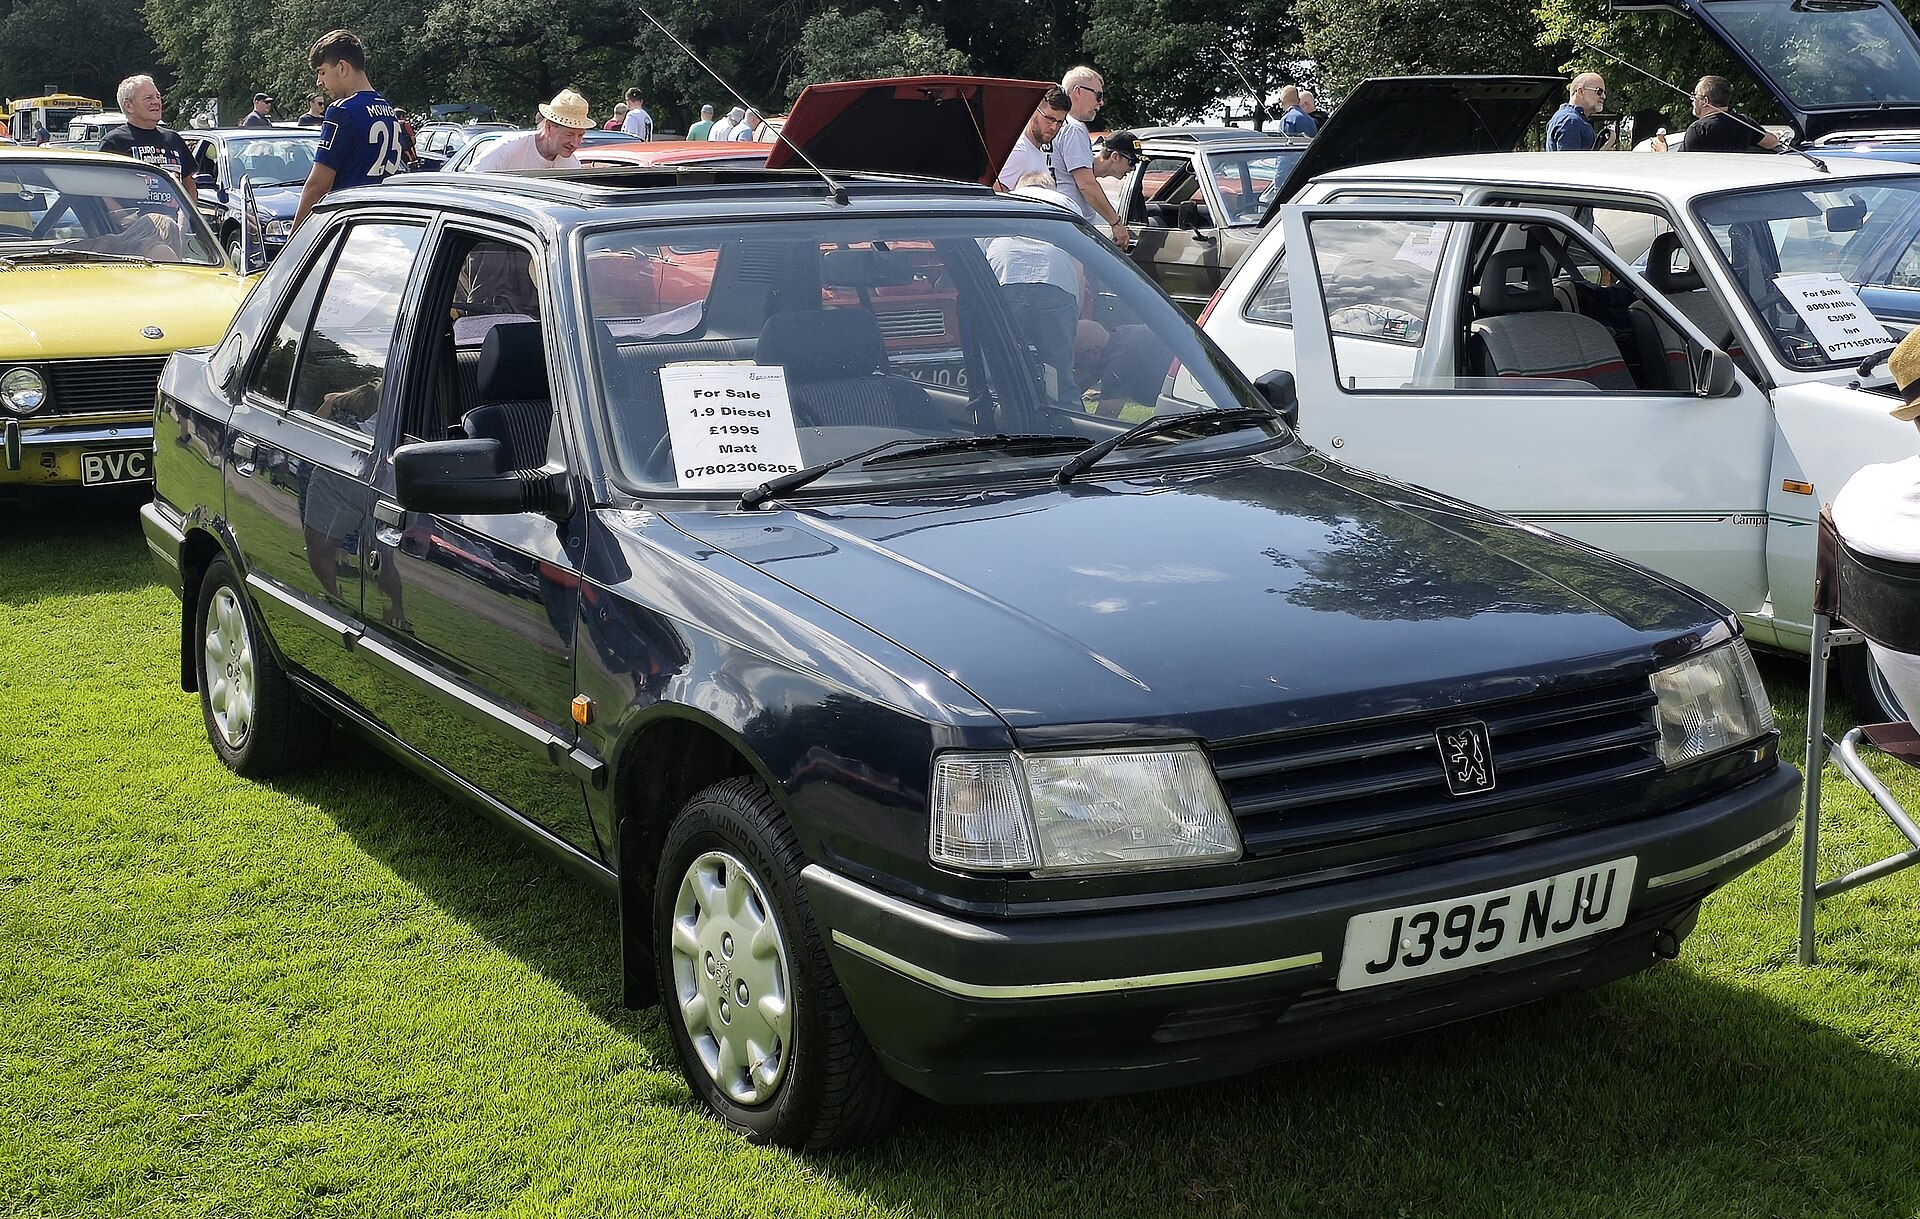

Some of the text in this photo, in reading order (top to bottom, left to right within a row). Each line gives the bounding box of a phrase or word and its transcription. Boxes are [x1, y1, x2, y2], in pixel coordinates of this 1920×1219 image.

[366, 104, 398, 118] MOWG
[366, 120, 402, 177] 25
[1802, 288, 1842, 299] For Sale
[1806, 300, 1857, 312] 8000 Miles
[1843, 326, 1861, 335] Ian
[693, 388, 761, 400] For Sale
[690, 406, 772, 418] 1.9 Diesel
[709, 425, 760, 436] £1995
[718, 444, 758, 454] Matt
[84, 452, 146, 483] BVC
[684, 462, 798, 479] 07802306205
[717, 814, 778, 898] UNIROYAL
[1364, 867, 1617, 975] J395 NJU
